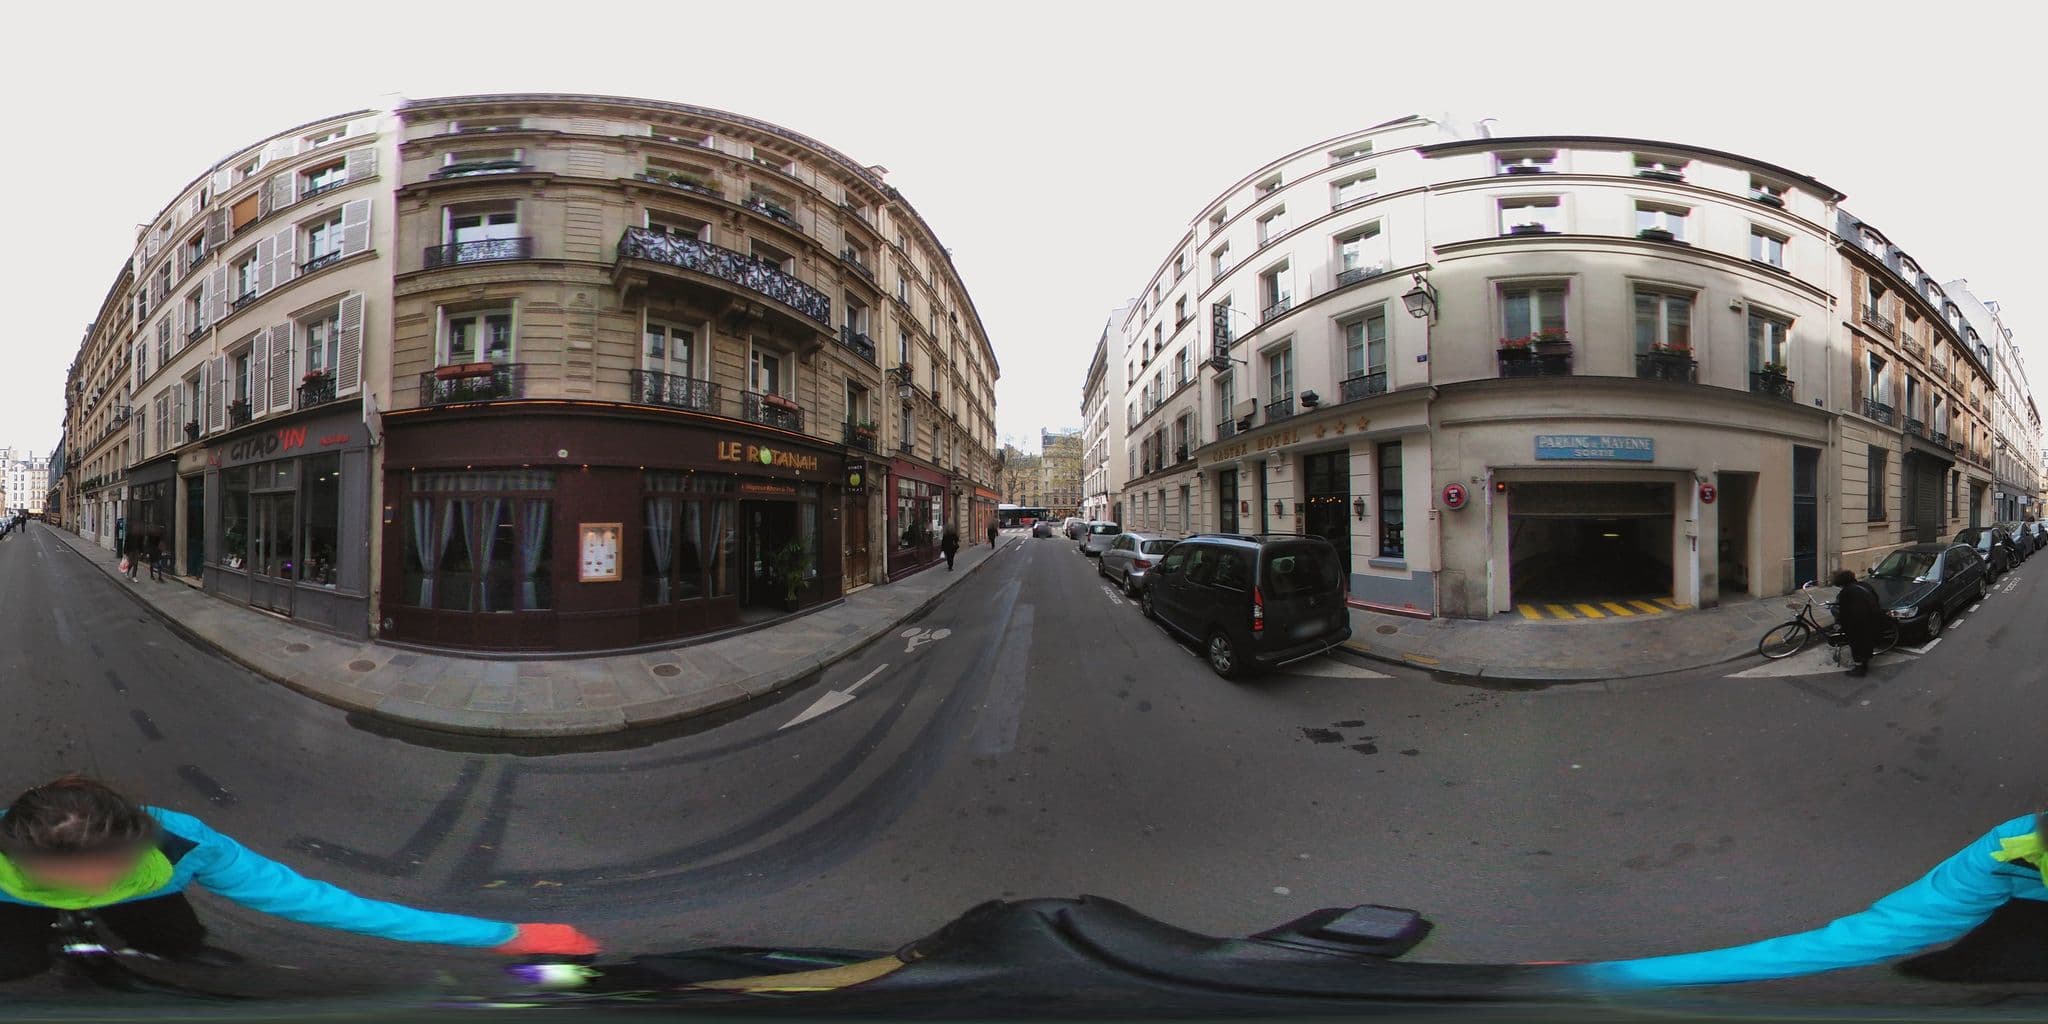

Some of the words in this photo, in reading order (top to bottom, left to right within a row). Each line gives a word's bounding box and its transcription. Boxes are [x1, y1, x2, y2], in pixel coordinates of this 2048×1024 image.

[1214, 305, 1228, 358] HOTEL
[718, 440, 742, 461] LE
[1257, 431, 1299, 451] HOTEL
[1538, 436, 1590, 448] PARKING
[1600, 437, 1651, 450] MAYENNE
[1574, 449, 1615, 457] SORTIE
